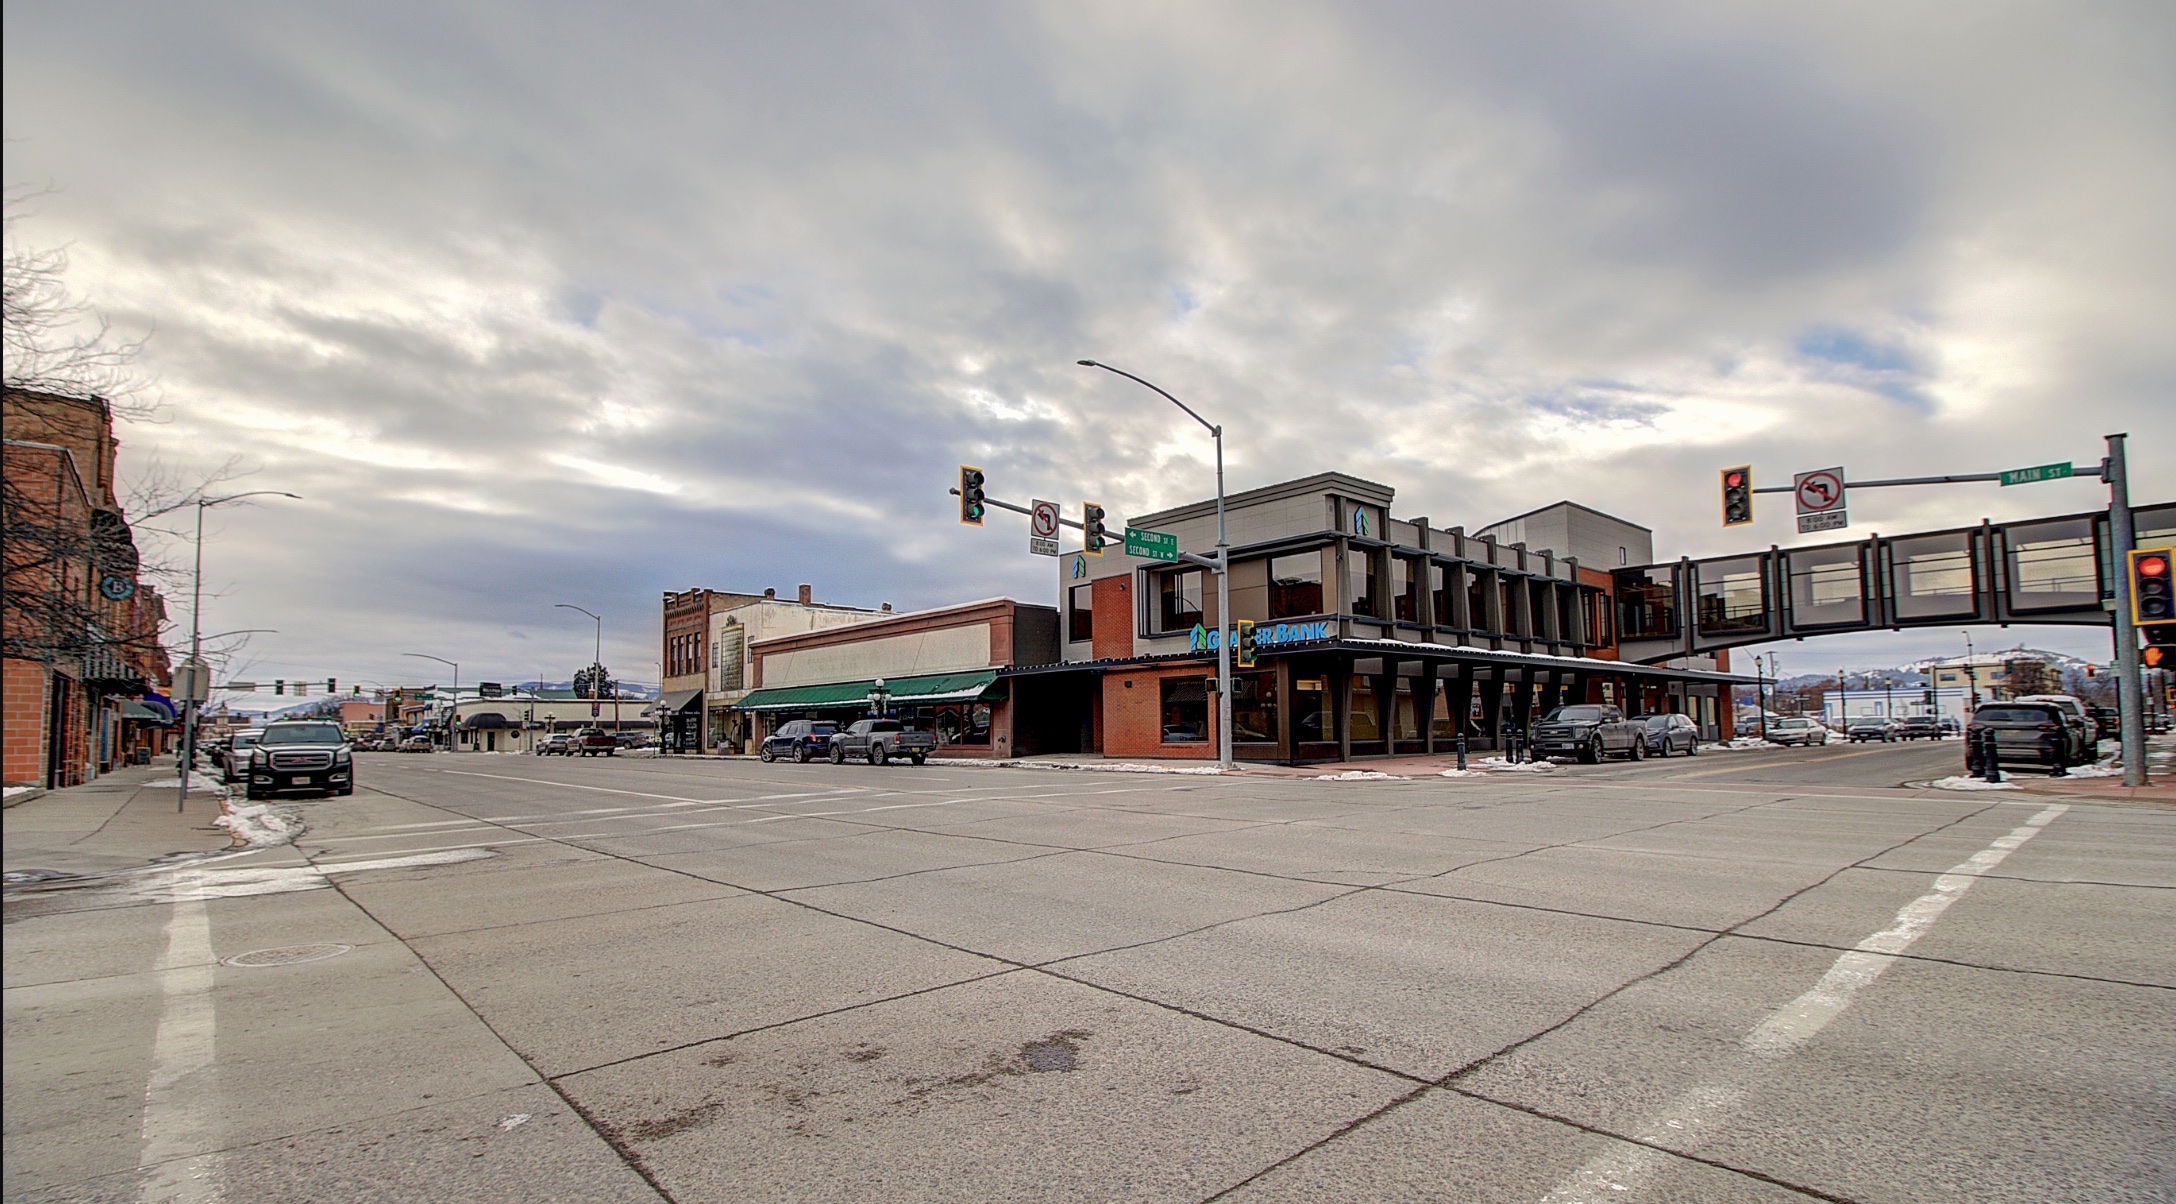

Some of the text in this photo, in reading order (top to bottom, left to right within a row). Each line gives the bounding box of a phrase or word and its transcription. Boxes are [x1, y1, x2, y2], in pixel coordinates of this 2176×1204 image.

[2008, 468, 2041, 484] MAIN
[1140, 531, 1161, 543] SECOND
[1163, 537, 1169, 545] ST
[1129, 545, 1150, 557] SECOND
[1152, 550, 1158, 558] ST
[1207, 621, 1329, 649] GAER BANK
